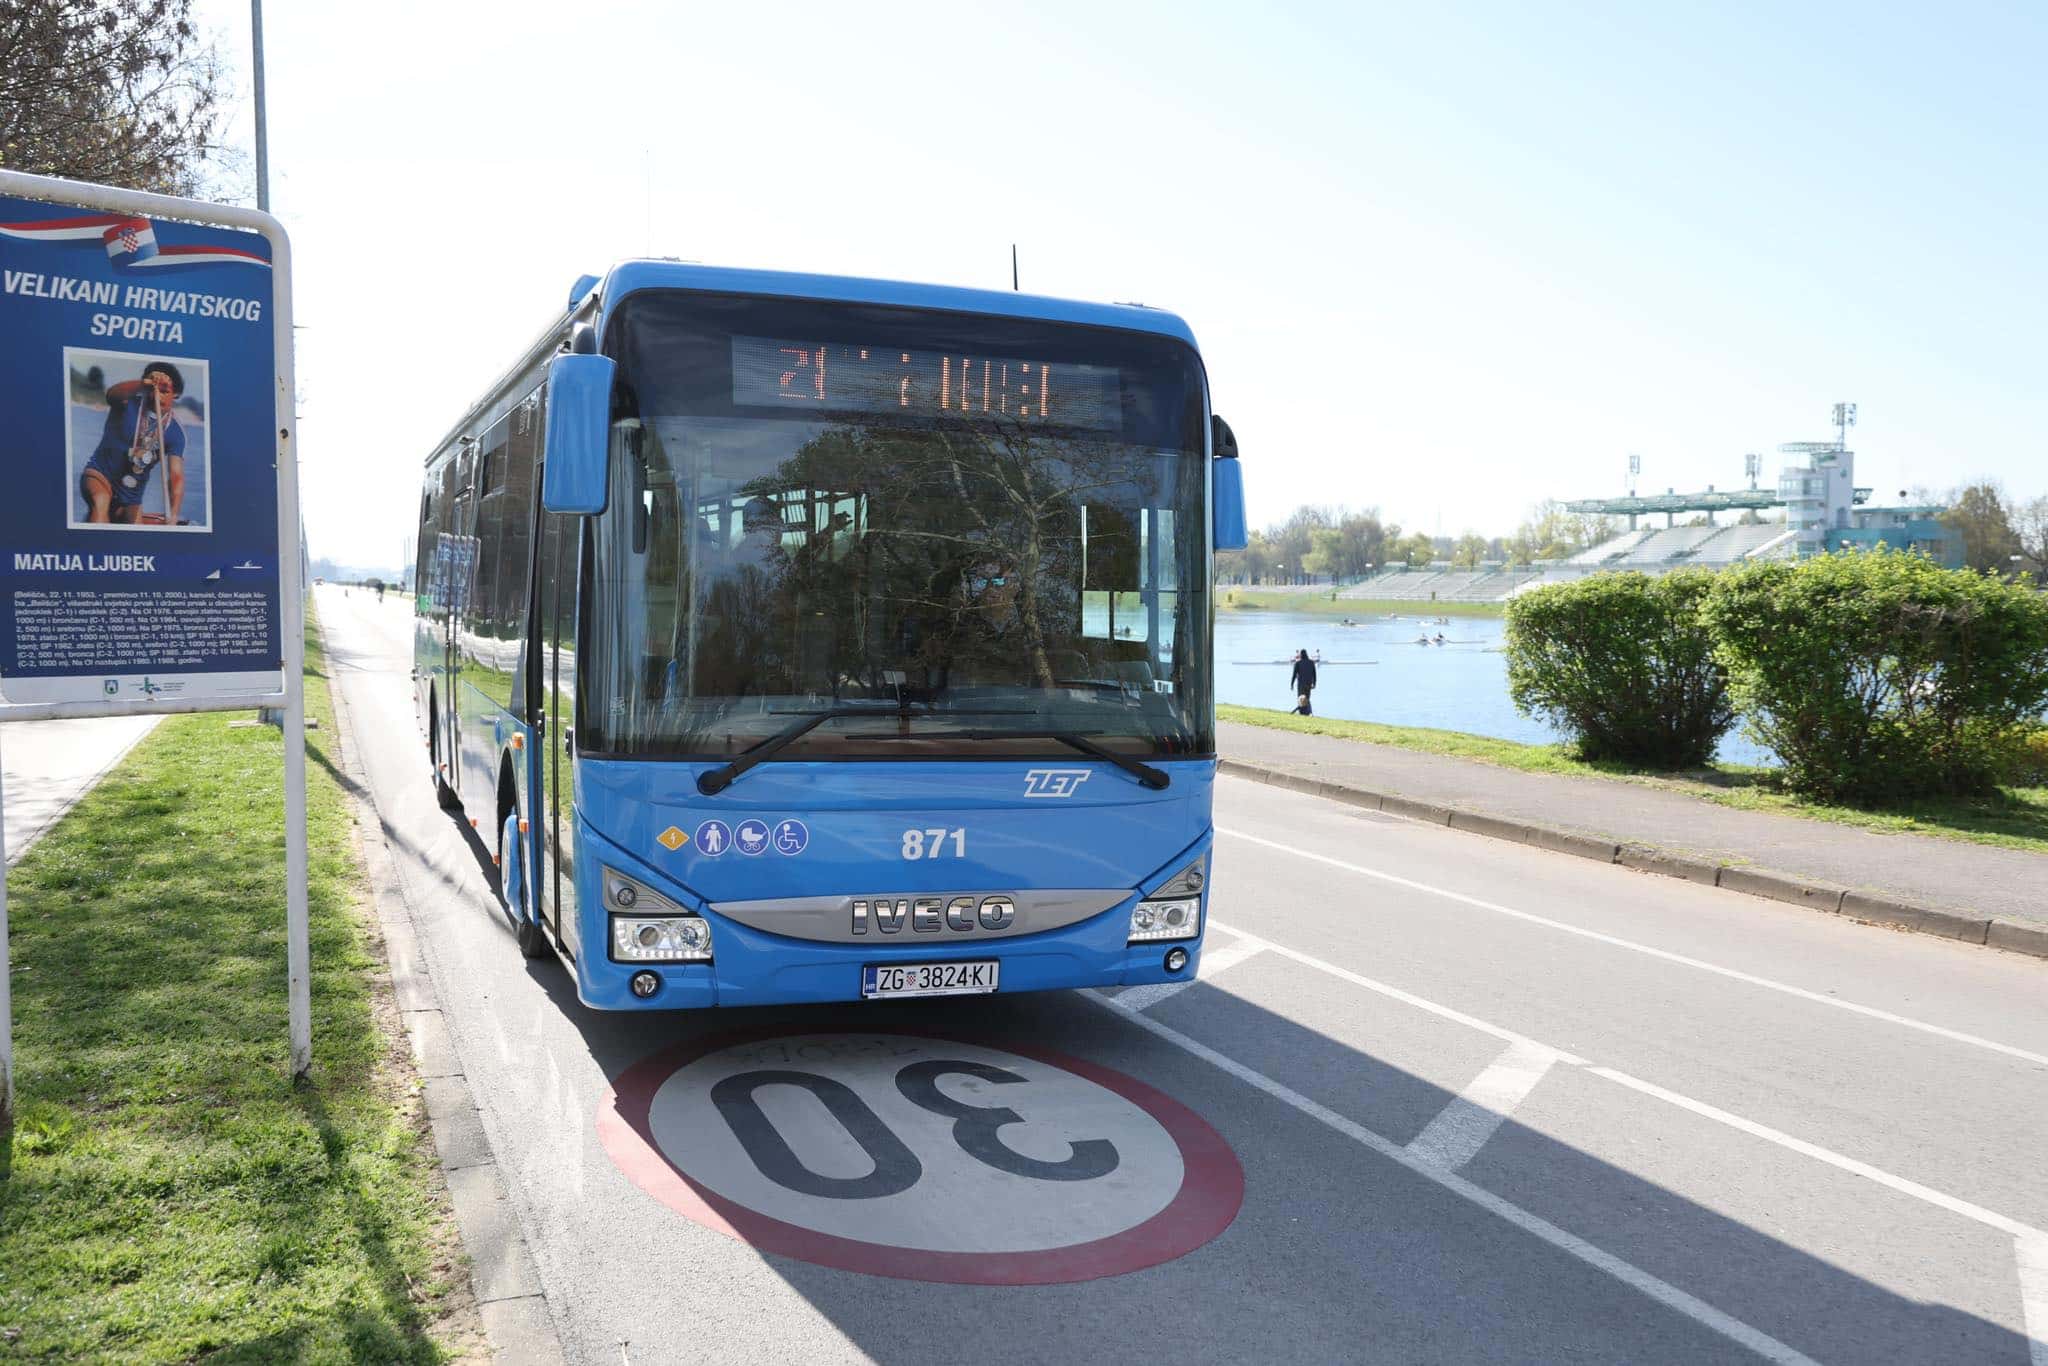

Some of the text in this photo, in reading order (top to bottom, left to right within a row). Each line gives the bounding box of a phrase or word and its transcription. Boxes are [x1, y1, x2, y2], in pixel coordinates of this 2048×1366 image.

[3, 271, 262, 322] VELIKANI HRVATSKOG
[90, 313, 183, 344] SPORTA
[14, 553, 156, 572] MATIJA LJUBEK
[1024, 769, 1091, 798] ZET
[901, 827, 966, 860] 871
[851, 894, 1016, 936] IVECO
[880, 969, 905, 990] ZG
[710, 1059, 1120, 1200] 30
